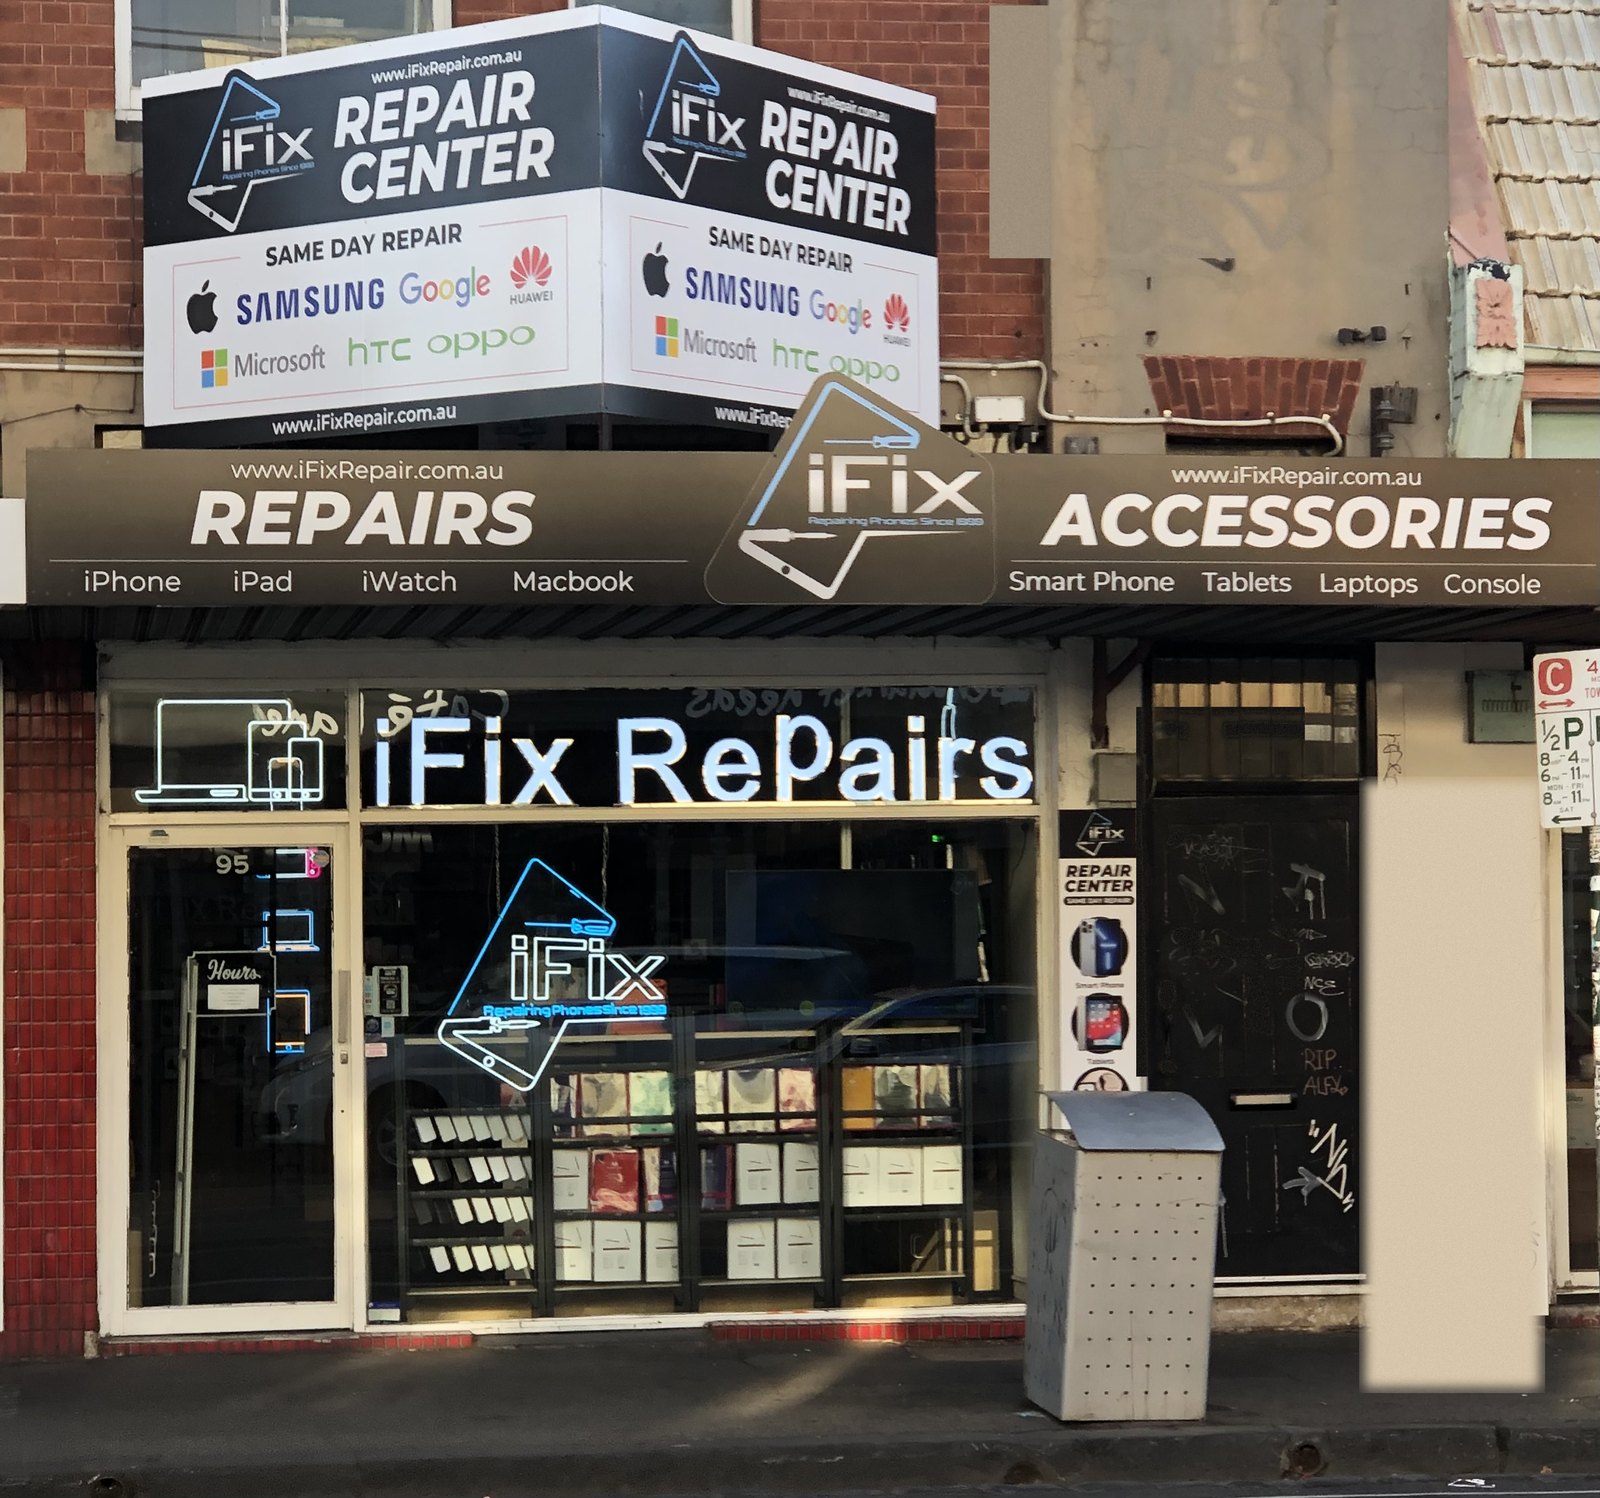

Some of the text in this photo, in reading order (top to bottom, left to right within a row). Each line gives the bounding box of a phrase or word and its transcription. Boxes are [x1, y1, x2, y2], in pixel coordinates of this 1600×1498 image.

[371, 49, 523, 85] www.iFixRepair.com.au
[333, 70, 536, 150] REPAIR
[672, 89, 747, 150] iFix
[222, 122, 314, 172] iFix
[760, 99, 899, 179] REPAIR
[340, 127, 556, 204] CENTER
[764, 157, 911, 237] CENTER
[265, 222, 463, 267] SAME DAY REPAIR
[708, 225, 853, 274] SAME DAY REPAIR
[236, 278, 385, 327] SAMSUNG
[399, 266, 491, 308] Google
[509, 289, 554, 306] HUAWEI
[685, 266, 800, 317] SAMSUNG
[809, 288, 872, 335] Google
[234, 344, 326, 379] Microsoft
[683, 327, 758, 363] Microsoft
[271, 404, 457, 436] www.iFixRepair.com.au
[714, 406, 793, 429] www.iFixRep
[230, 460, 504, 482] www.iFixRepair.com.au
[808, 453, 984, 514] iFix
[1172, 465, 1423, 488] www.iFixRepair.com.au
[190, 490, 535, 547] REPAIRS
[1040, 493, 1553, 551] ACCESSORIES
[84, 570, 181, 594] iPhone
[233, 570, 293, 593] iPad
[362, 570, 457, 594] iWatch
[513, 571, 635, 594] Macbook
[1009, 571, 1175, 594] Smart Phone
[1202, 571, 1293, 594] Tablets
[1319, 572, 1419, 600] Laptops
[1443, 573, 1542, 596] Console
[375, 714, 1034, 807] iFix Repairs
[215, 854, 250, 875] 95
[1066, 865, 1132, 878] REPAIR
[1065, 880, 1134, 893] CENTER
[207, 959, 262, 981] Hours
[511, 934, 666, 1001] iFix
[483, 1003, 550, 1018] Repairing
[551, 1003, 601, 1016] Phones
[602, 1002, 638, 1015] Since
[1304, 1048, 1337, 1071] RIP
